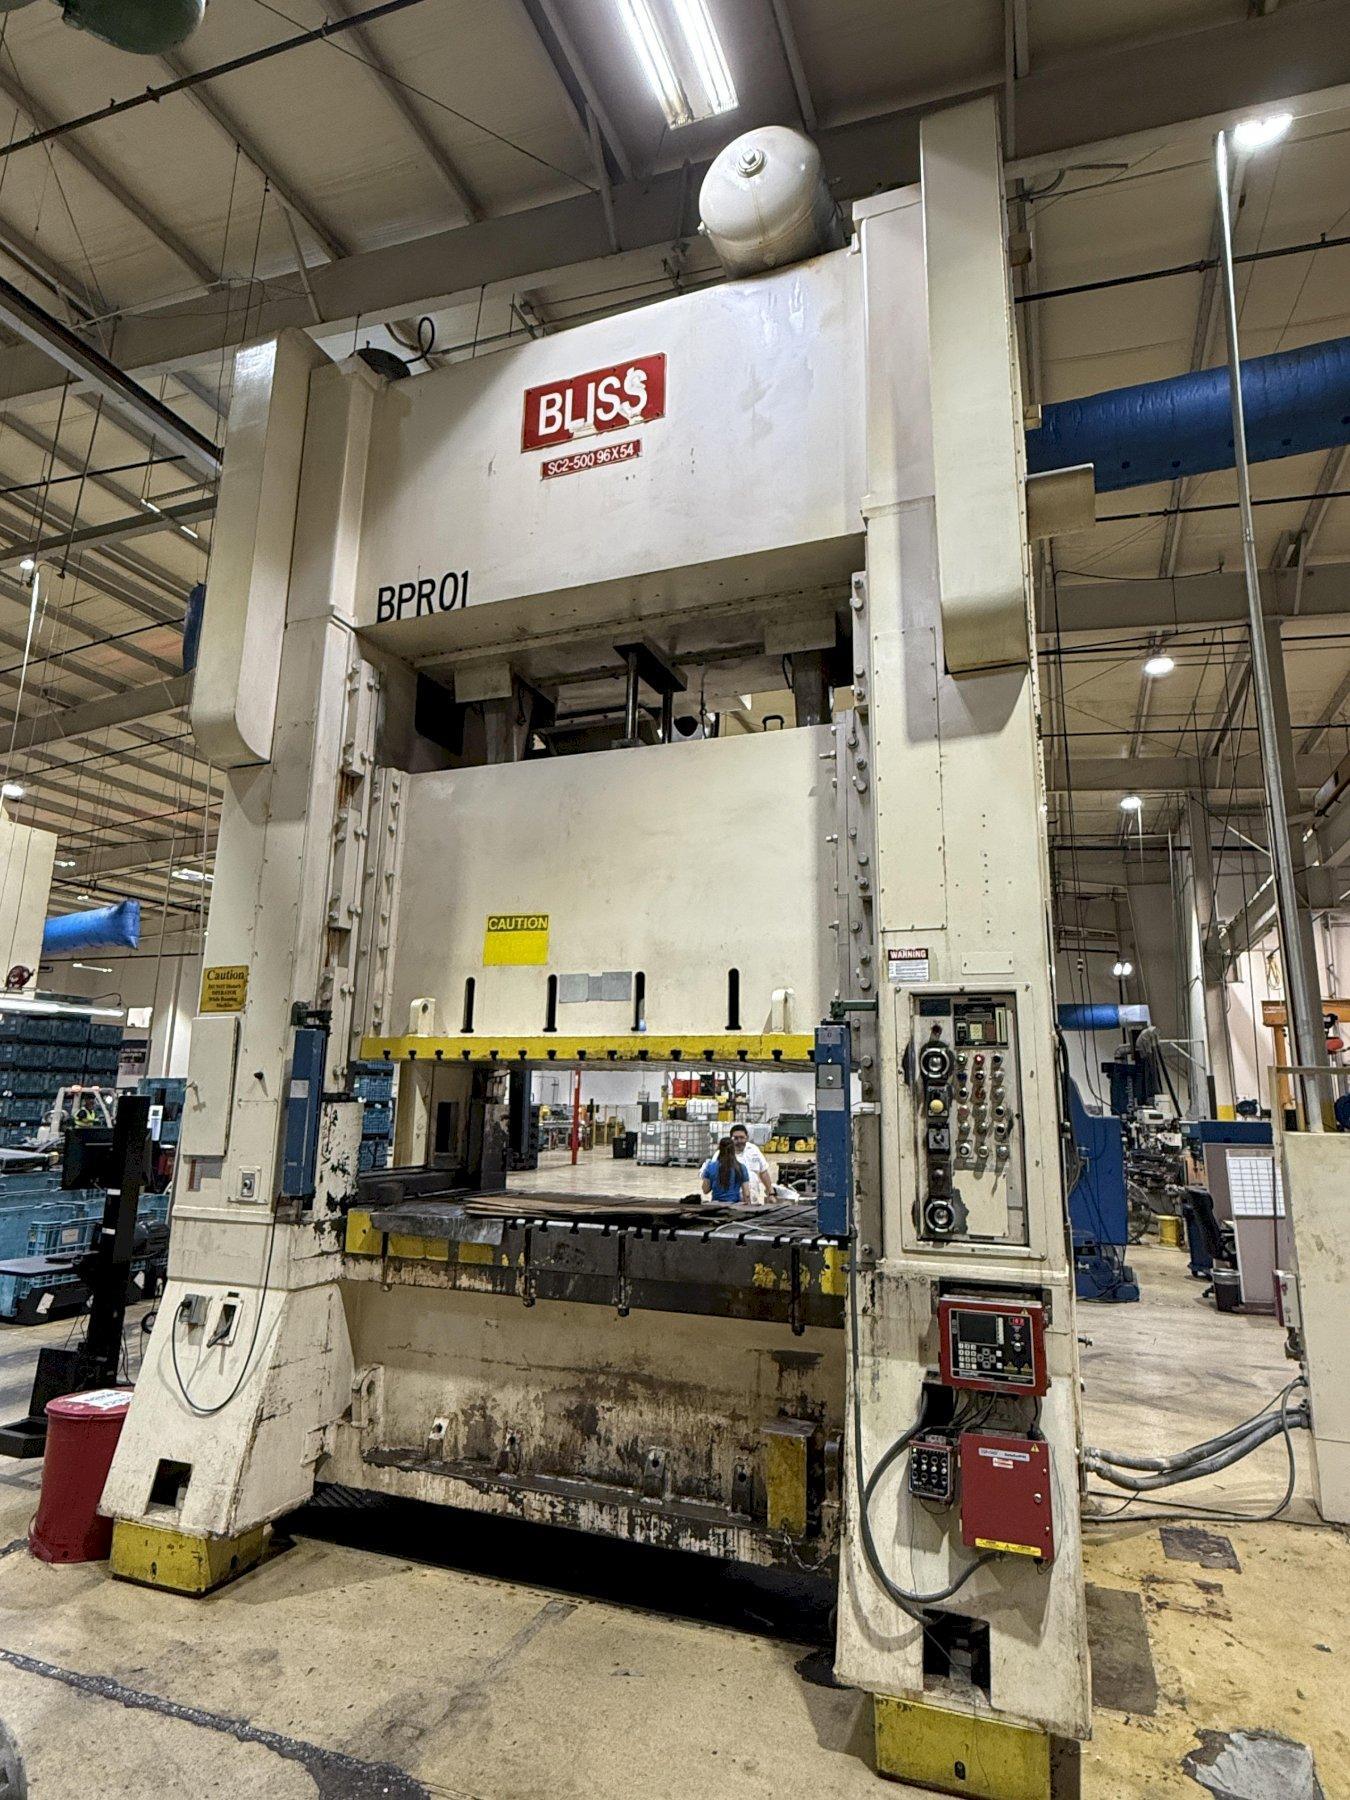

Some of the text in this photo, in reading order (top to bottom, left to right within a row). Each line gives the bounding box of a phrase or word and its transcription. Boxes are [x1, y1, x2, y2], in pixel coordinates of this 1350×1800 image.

[538, 367, 648, 436] BLISS
[547, 442, 634, 475] SC2-500 96X54
[377, 570, 469, 624] BPR01
[488, 917, 548, 931] CAUTION
[890, 950, 927, 960] WARNING
[207, 969, 245, 981] Caution
